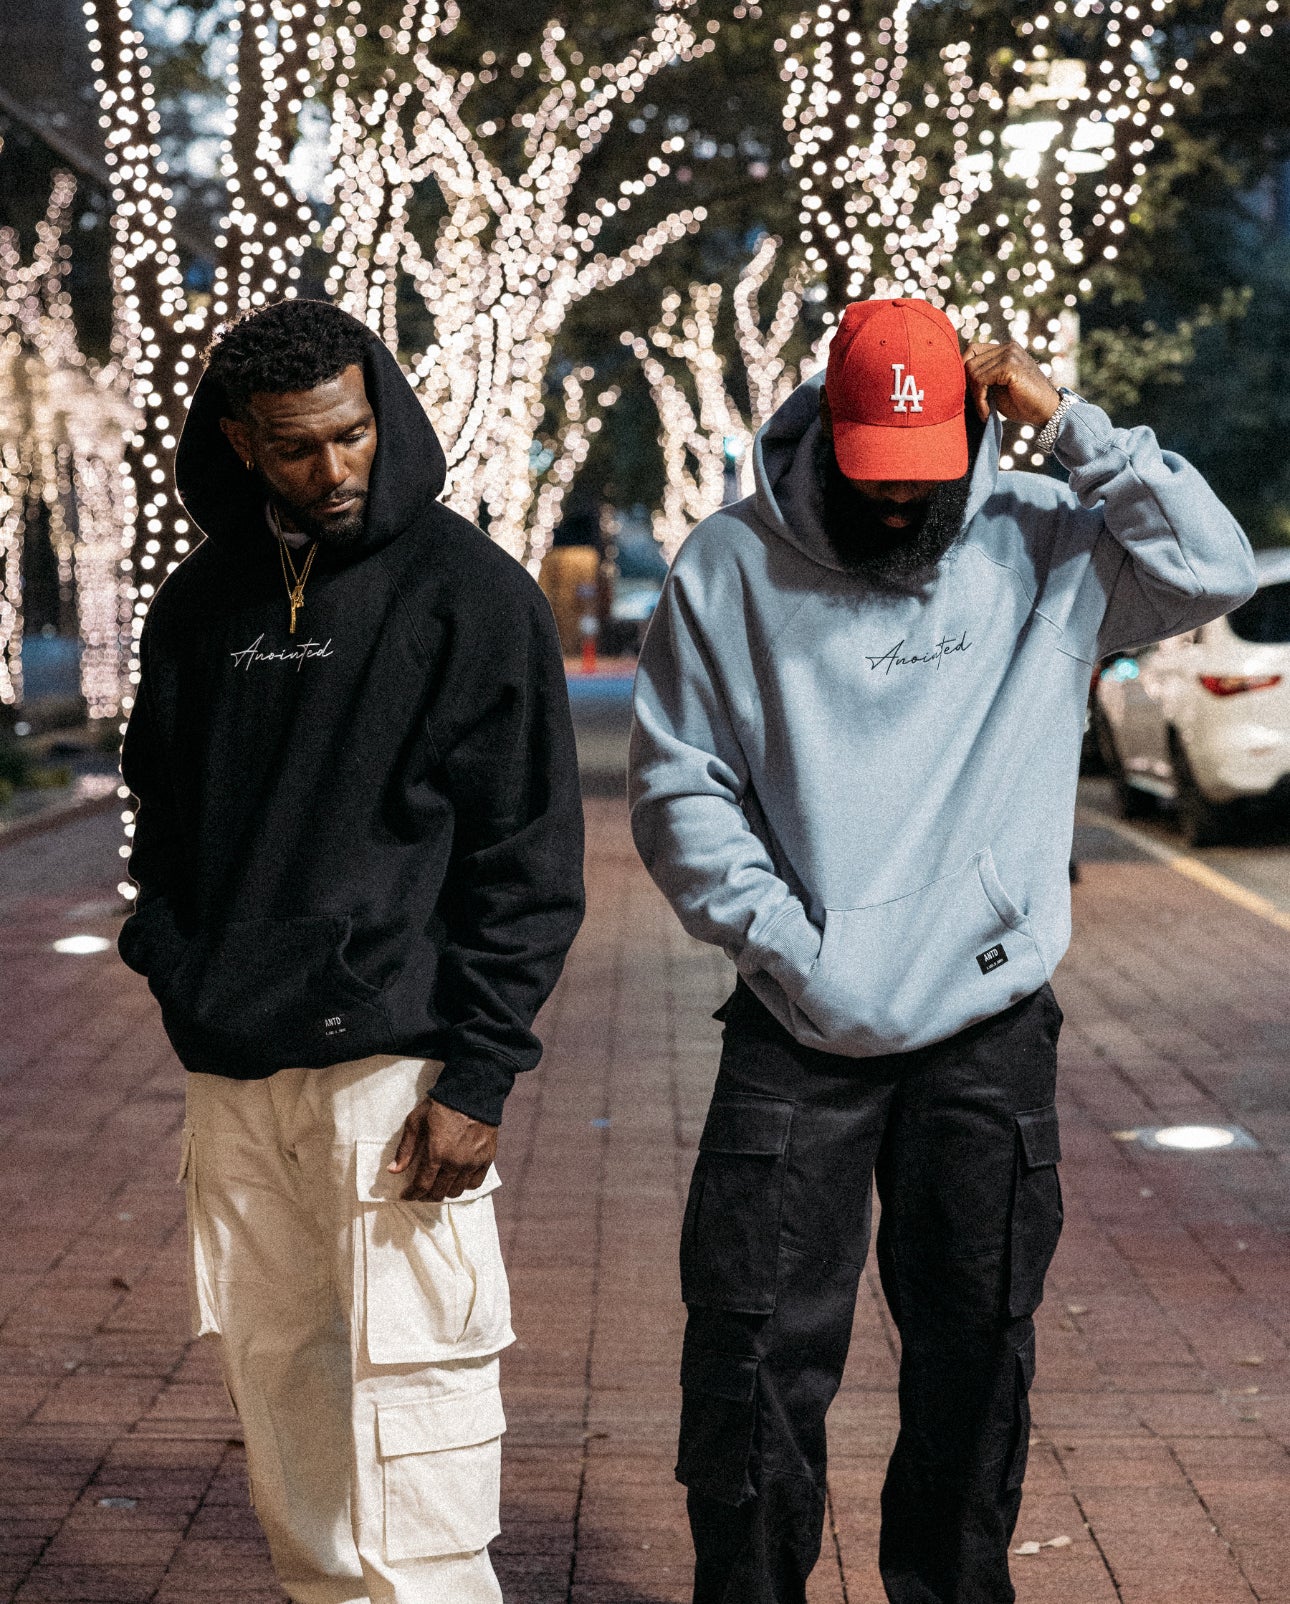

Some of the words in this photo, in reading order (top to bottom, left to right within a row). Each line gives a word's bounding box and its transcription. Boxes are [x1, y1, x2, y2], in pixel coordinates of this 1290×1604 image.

[890, 363, 925, 413] LA
[230, 632, 334, 672] Anointed
[864, 630, 973, 675] Anointed
[983, 948, 999, 962] ANTD
